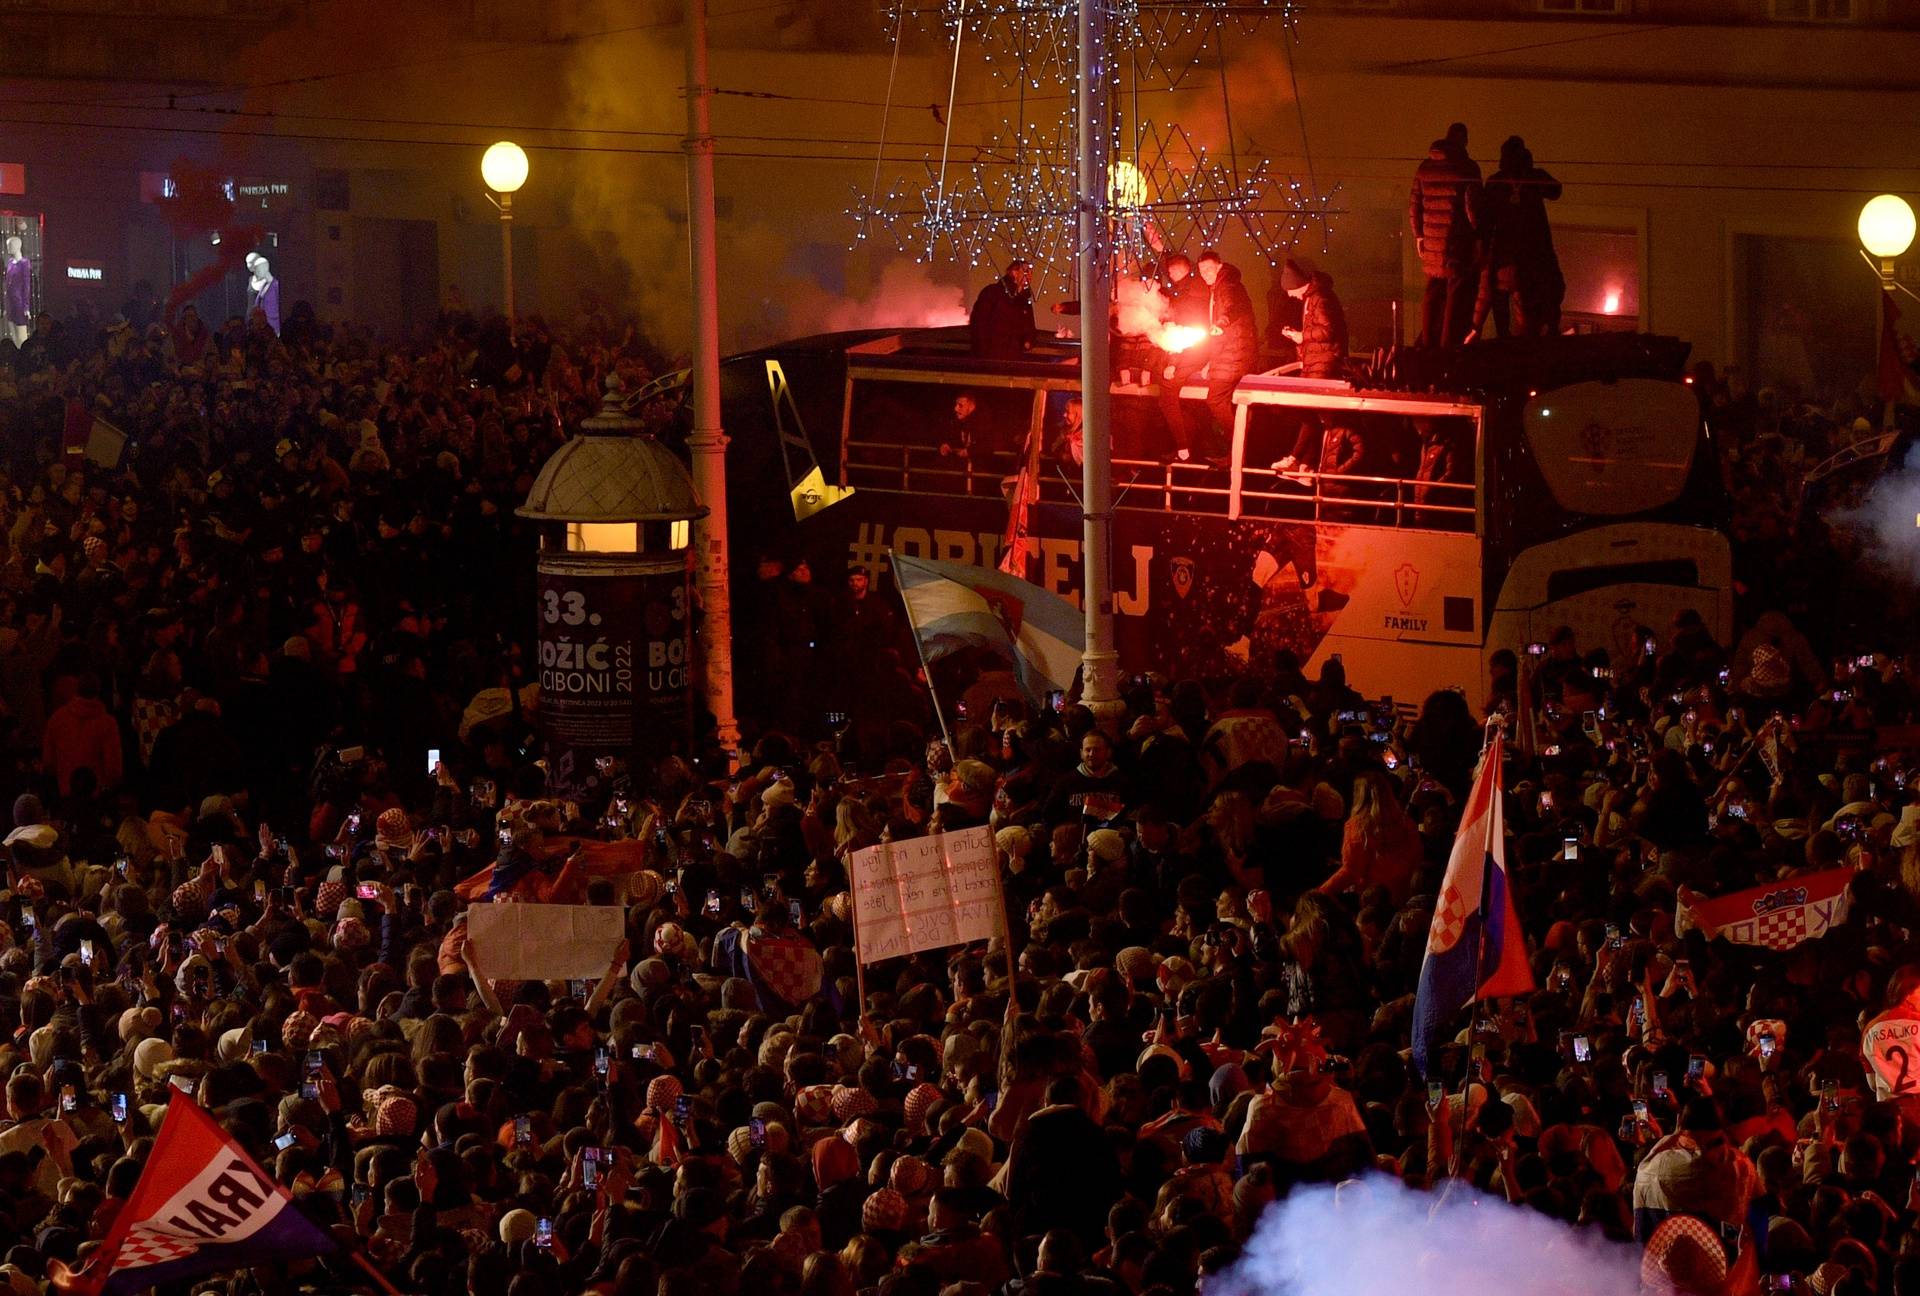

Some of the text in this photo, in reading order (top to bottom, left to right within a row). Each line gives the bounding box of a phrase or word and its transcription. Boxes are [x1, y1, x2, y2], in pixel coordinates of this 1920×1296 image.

[544, 589, 602, 626] 33.
[1384, 616, 1428, 631] FAMILY
[615, 640, 632, 692] 2022.
[542, 670, 610, 693] CIBONI
[649, 671, 663, 691] U
